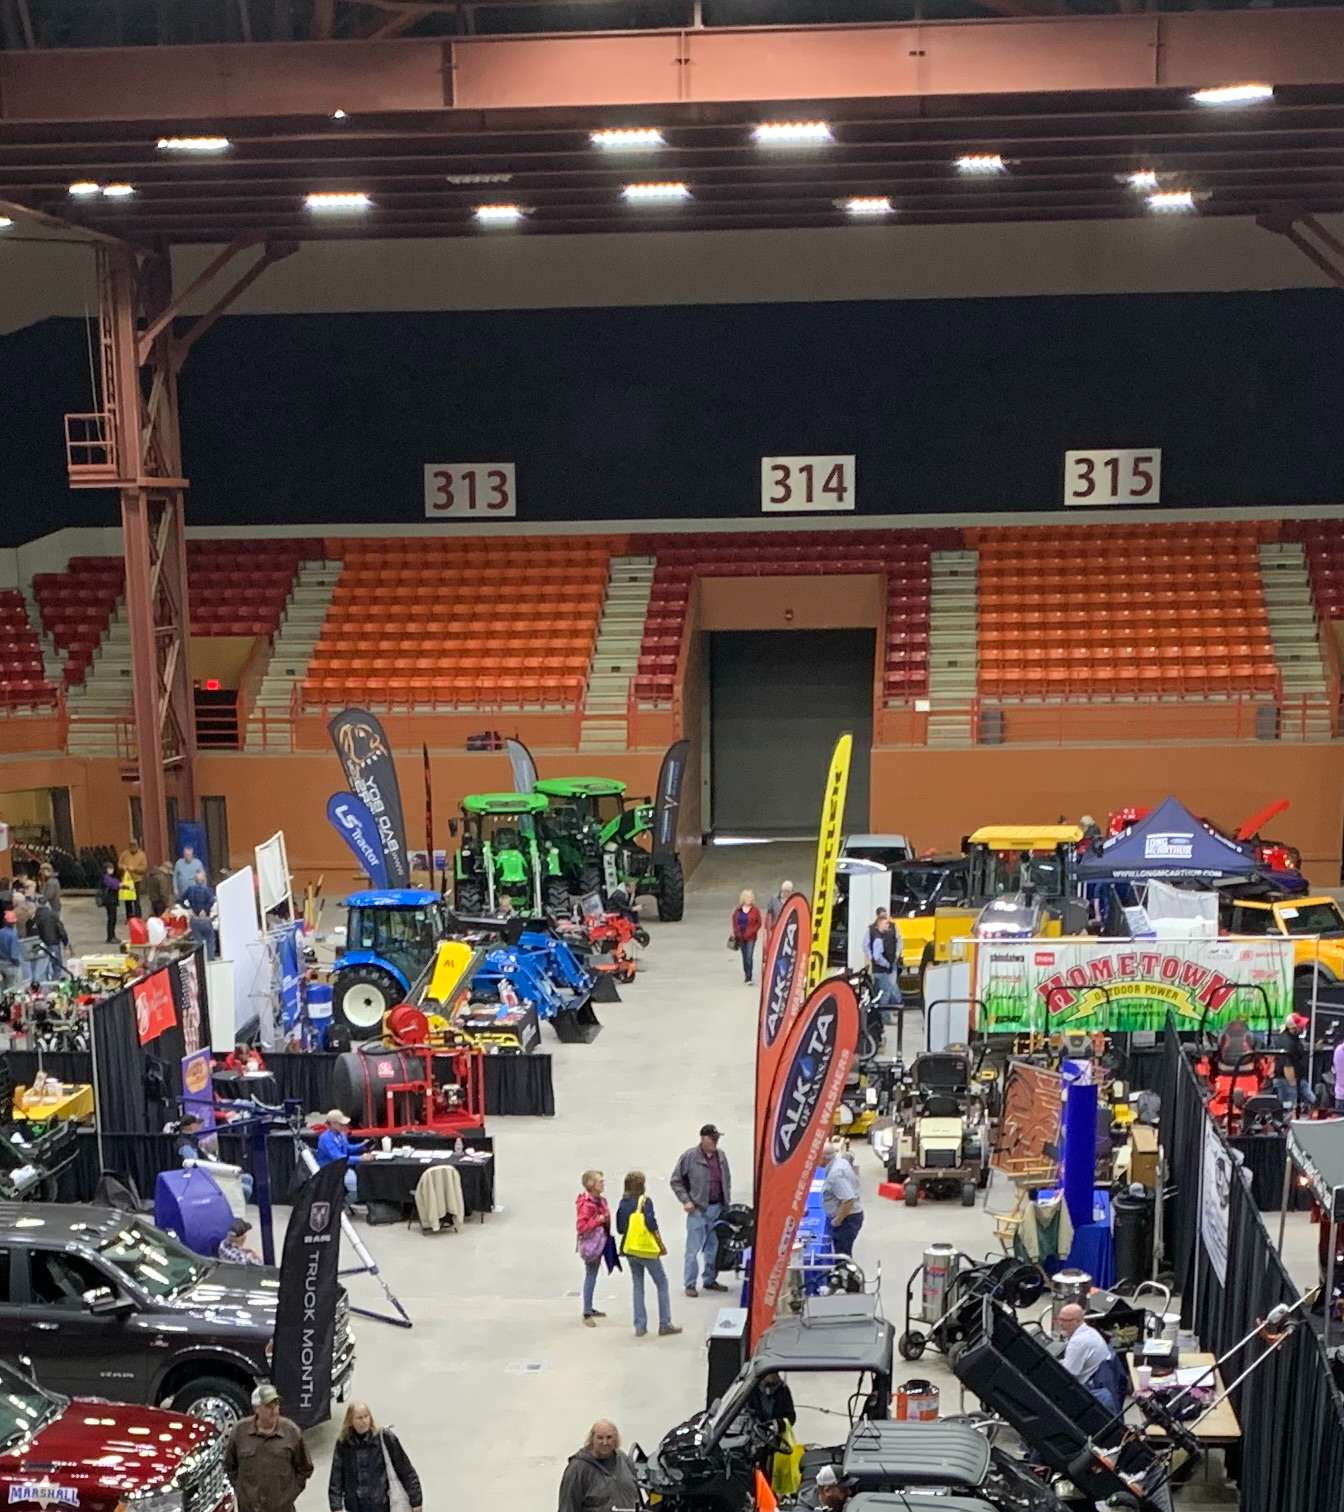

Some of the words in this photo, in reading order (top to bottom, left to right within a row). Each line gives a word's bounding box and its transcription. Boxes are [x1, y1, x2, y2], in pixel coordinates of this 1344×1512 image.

[431, 471, 511, 511] 313
[769, 464, 848, 504] 314
[1073, 457, 1152, 497] 315
[351, 827, 380, 867] Tractor
[1037, 952, 1237, 1016] HOMETOWN
[1094, 984, 1141, 1001] OUTDOOR
[1144, 984, 1180, 999] POWER
[792, 1128, 825, 1212] PRESSURE
[819, 1049, 851, 1128] WASHERS
[303, 1250, 320, 1322] TRUCK
[299, 1328, 314, 1409] MONTH
[11, 1486, 79, 1504] MARSHALL
